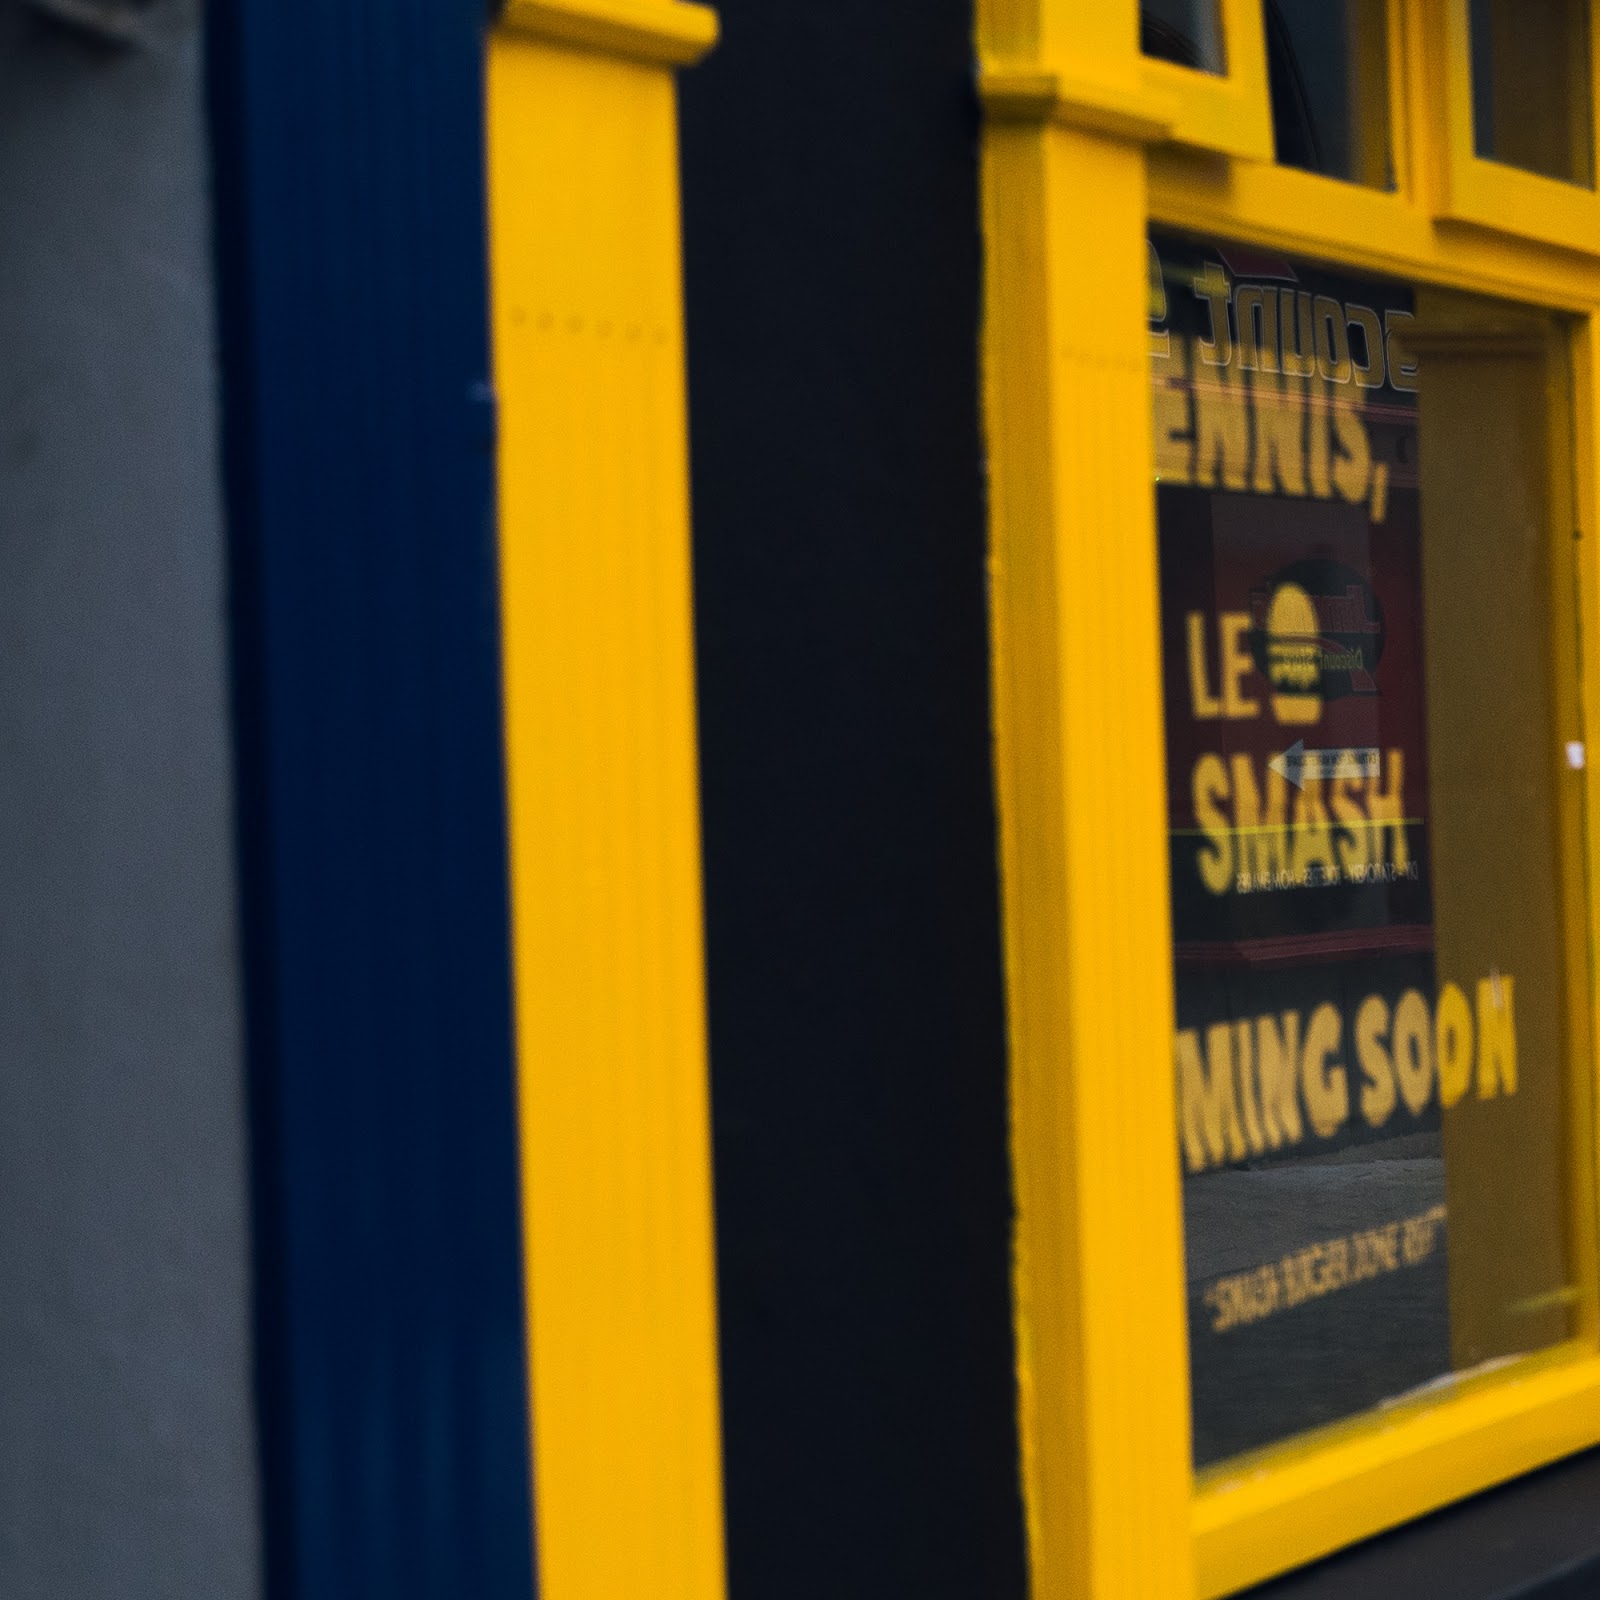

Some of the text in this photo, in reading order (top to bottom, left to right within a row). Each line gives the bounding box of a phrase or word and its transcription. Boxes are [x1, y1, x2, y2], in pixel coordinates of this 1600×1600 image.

[1187, 611, 1260, 718] LE
[1190, 747, 1411, 895] SMASH
[1354, 974, 1518, 1130] SOON
